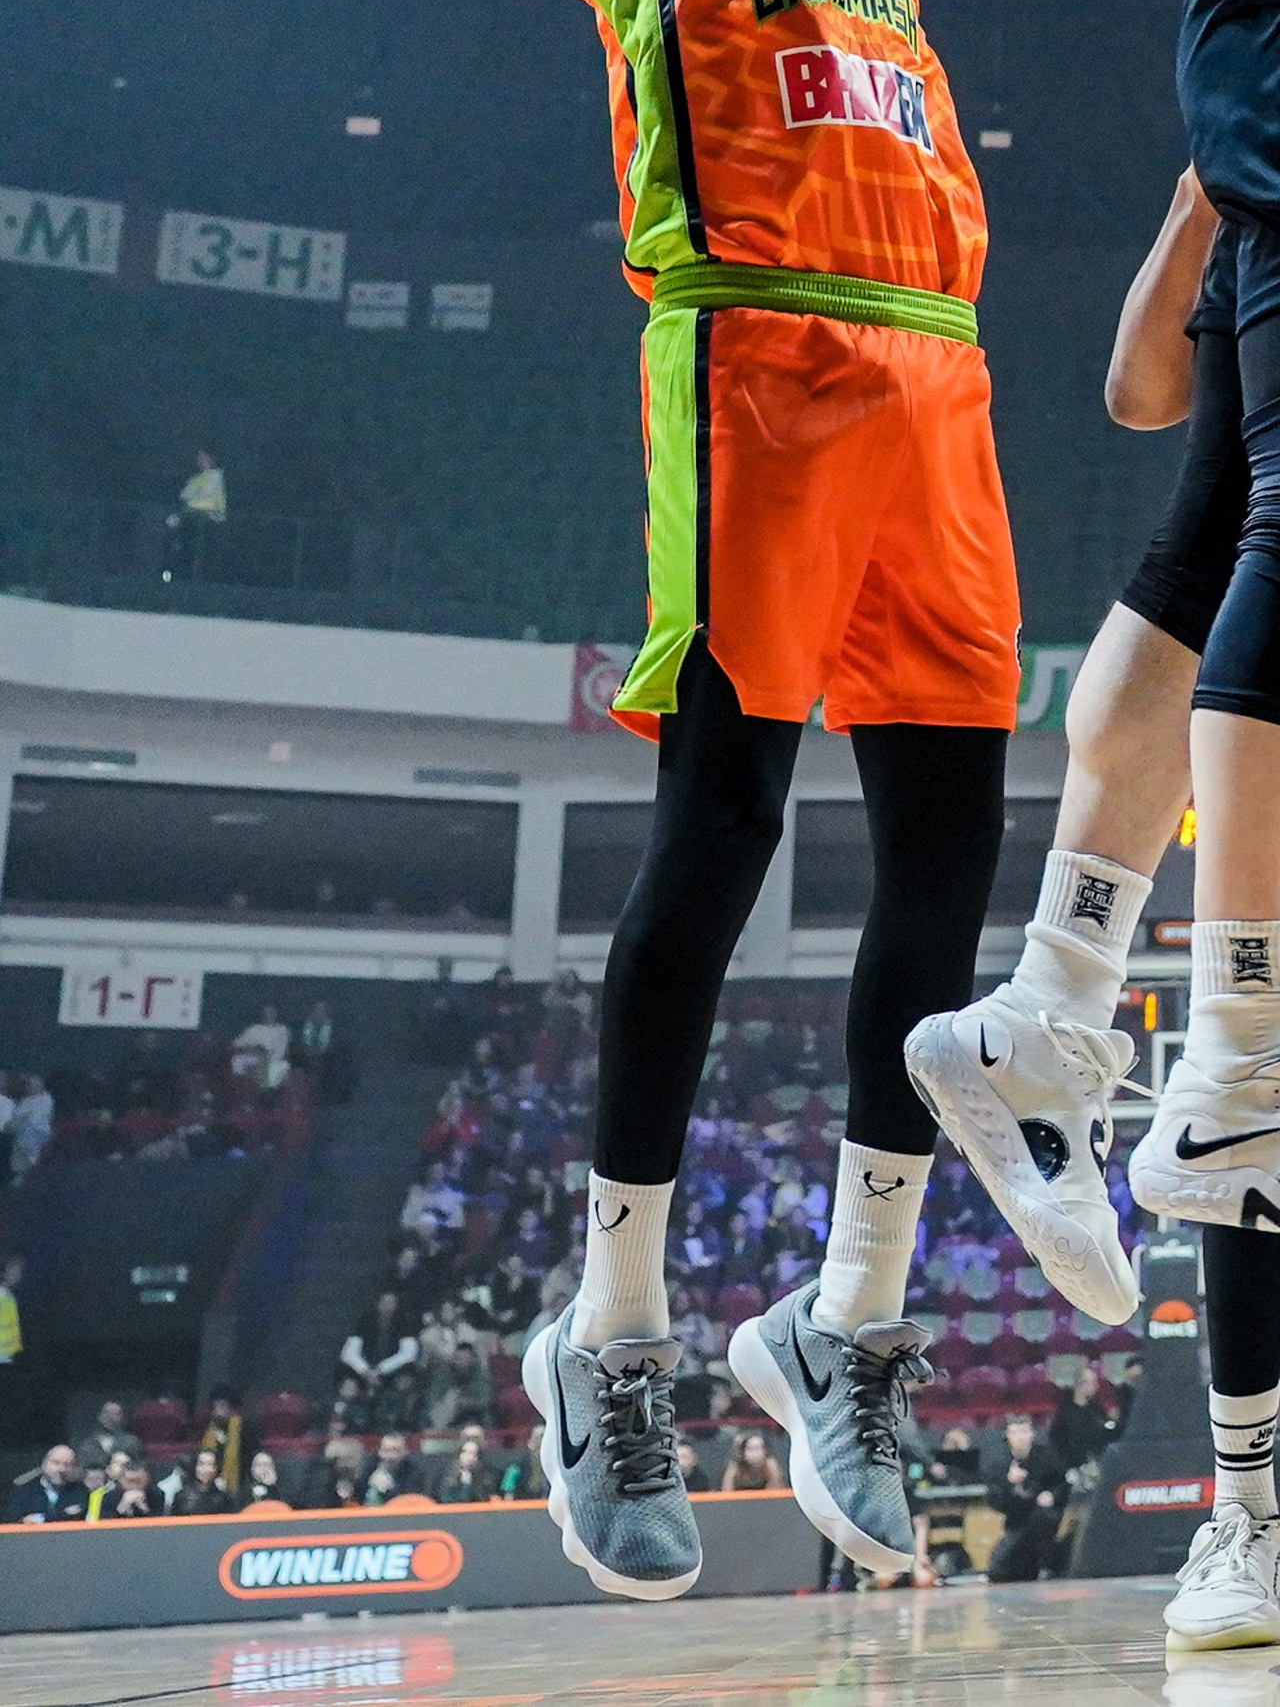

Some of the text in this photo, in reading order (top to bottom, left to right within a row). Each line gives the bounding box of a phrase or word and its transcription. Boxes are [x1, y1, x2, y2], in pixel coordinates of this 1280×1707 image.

[1069, 872, 1120, 931] PEAK
[1229, 936, 1272, 985] PEAK
[89, 976, 174, 1018] 1-Г
[239, 1543, 414, 1588] WINLINE
